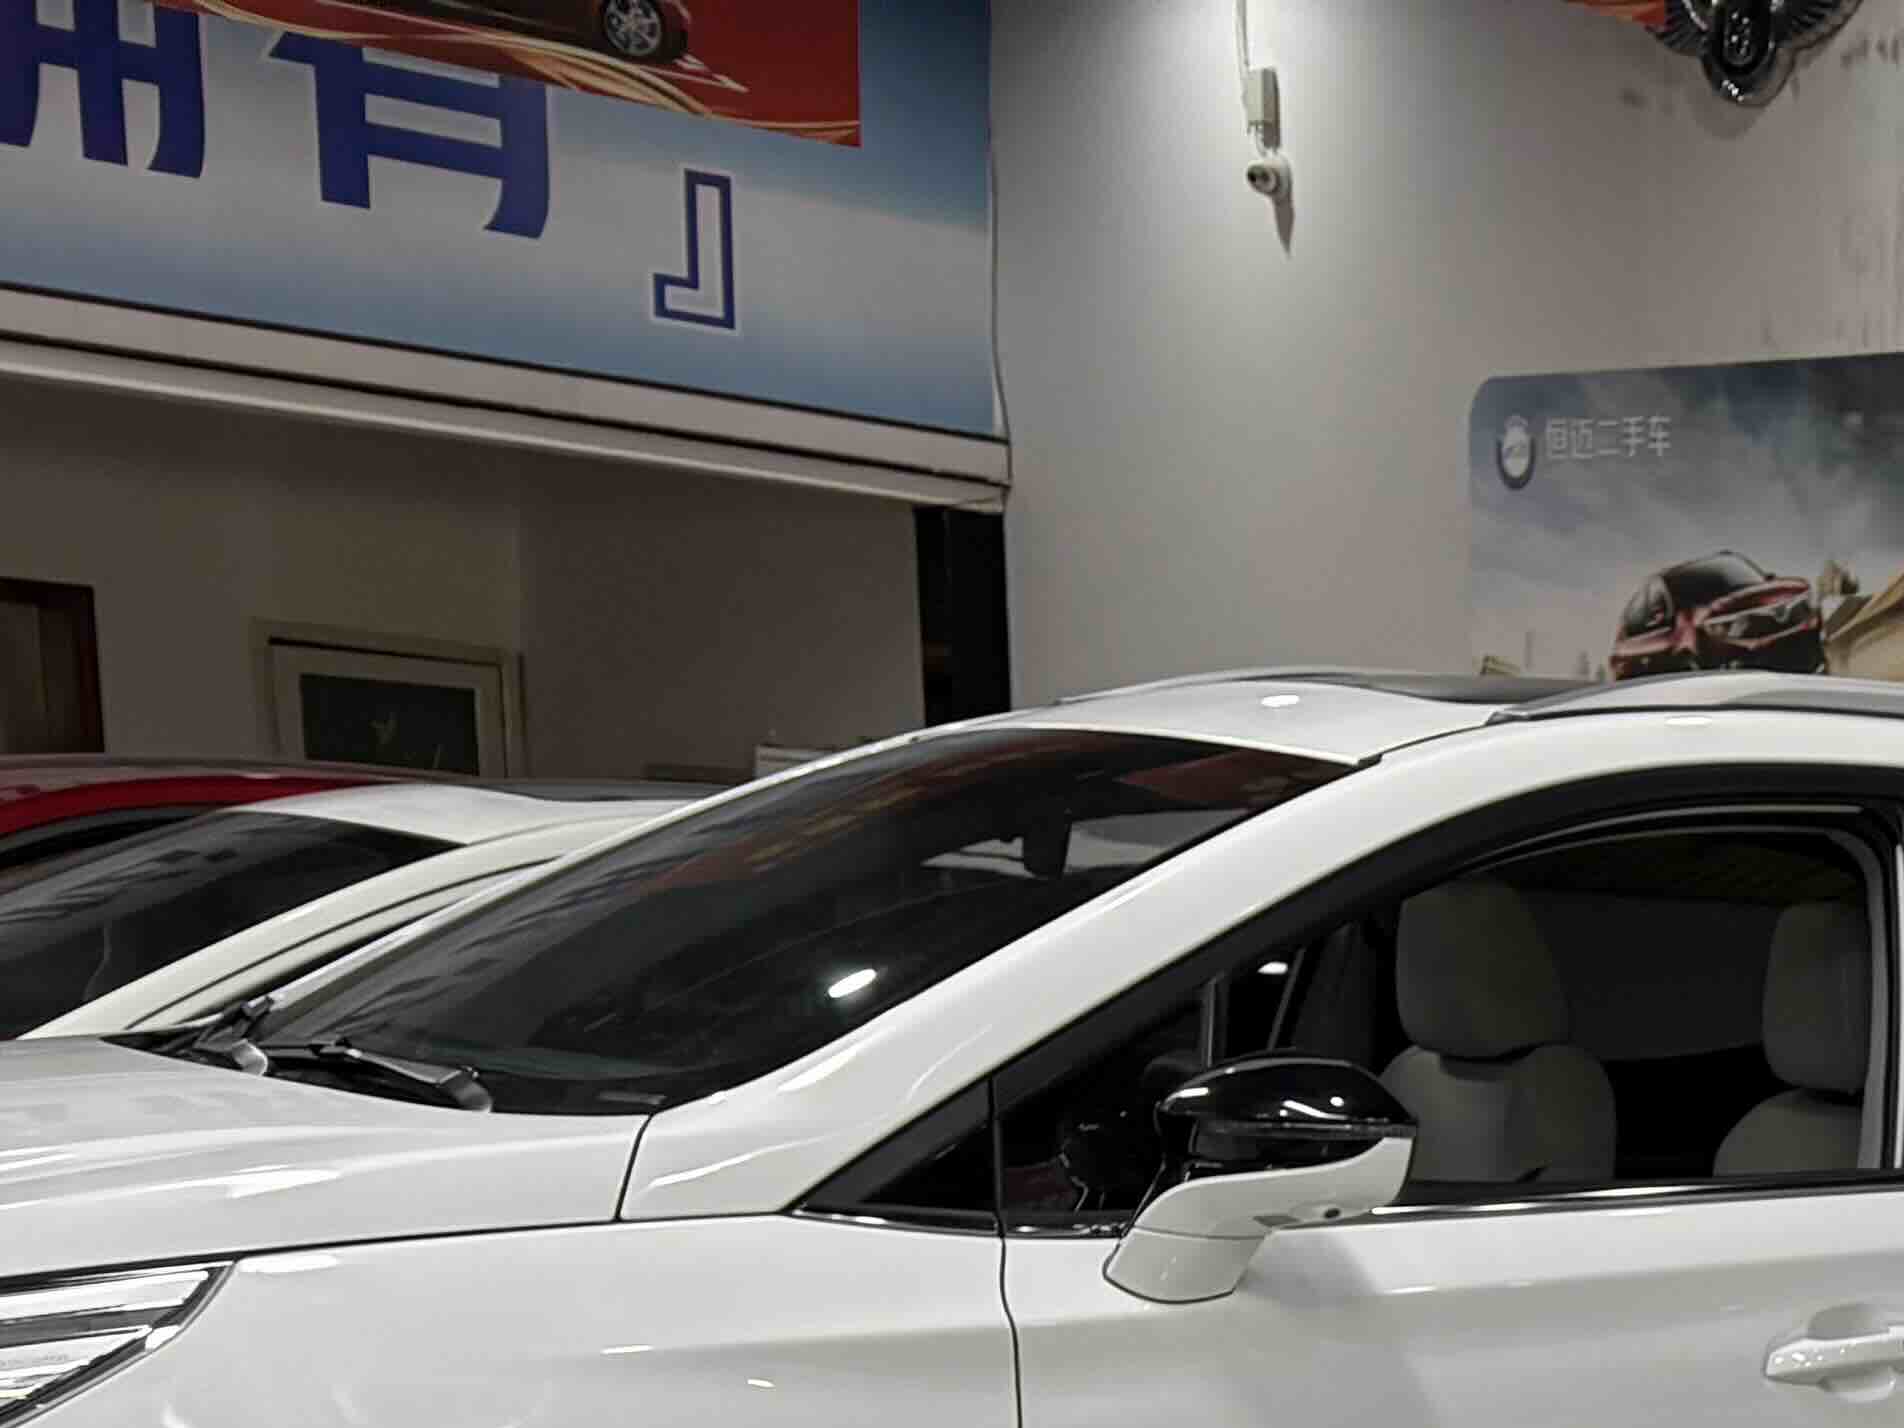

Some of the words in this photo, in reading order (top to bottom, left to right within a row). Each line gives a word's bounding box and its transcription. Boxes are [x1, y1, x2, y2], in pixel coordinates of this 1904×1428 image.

[1545, 413, 1672, 460] 恒迈二手车
